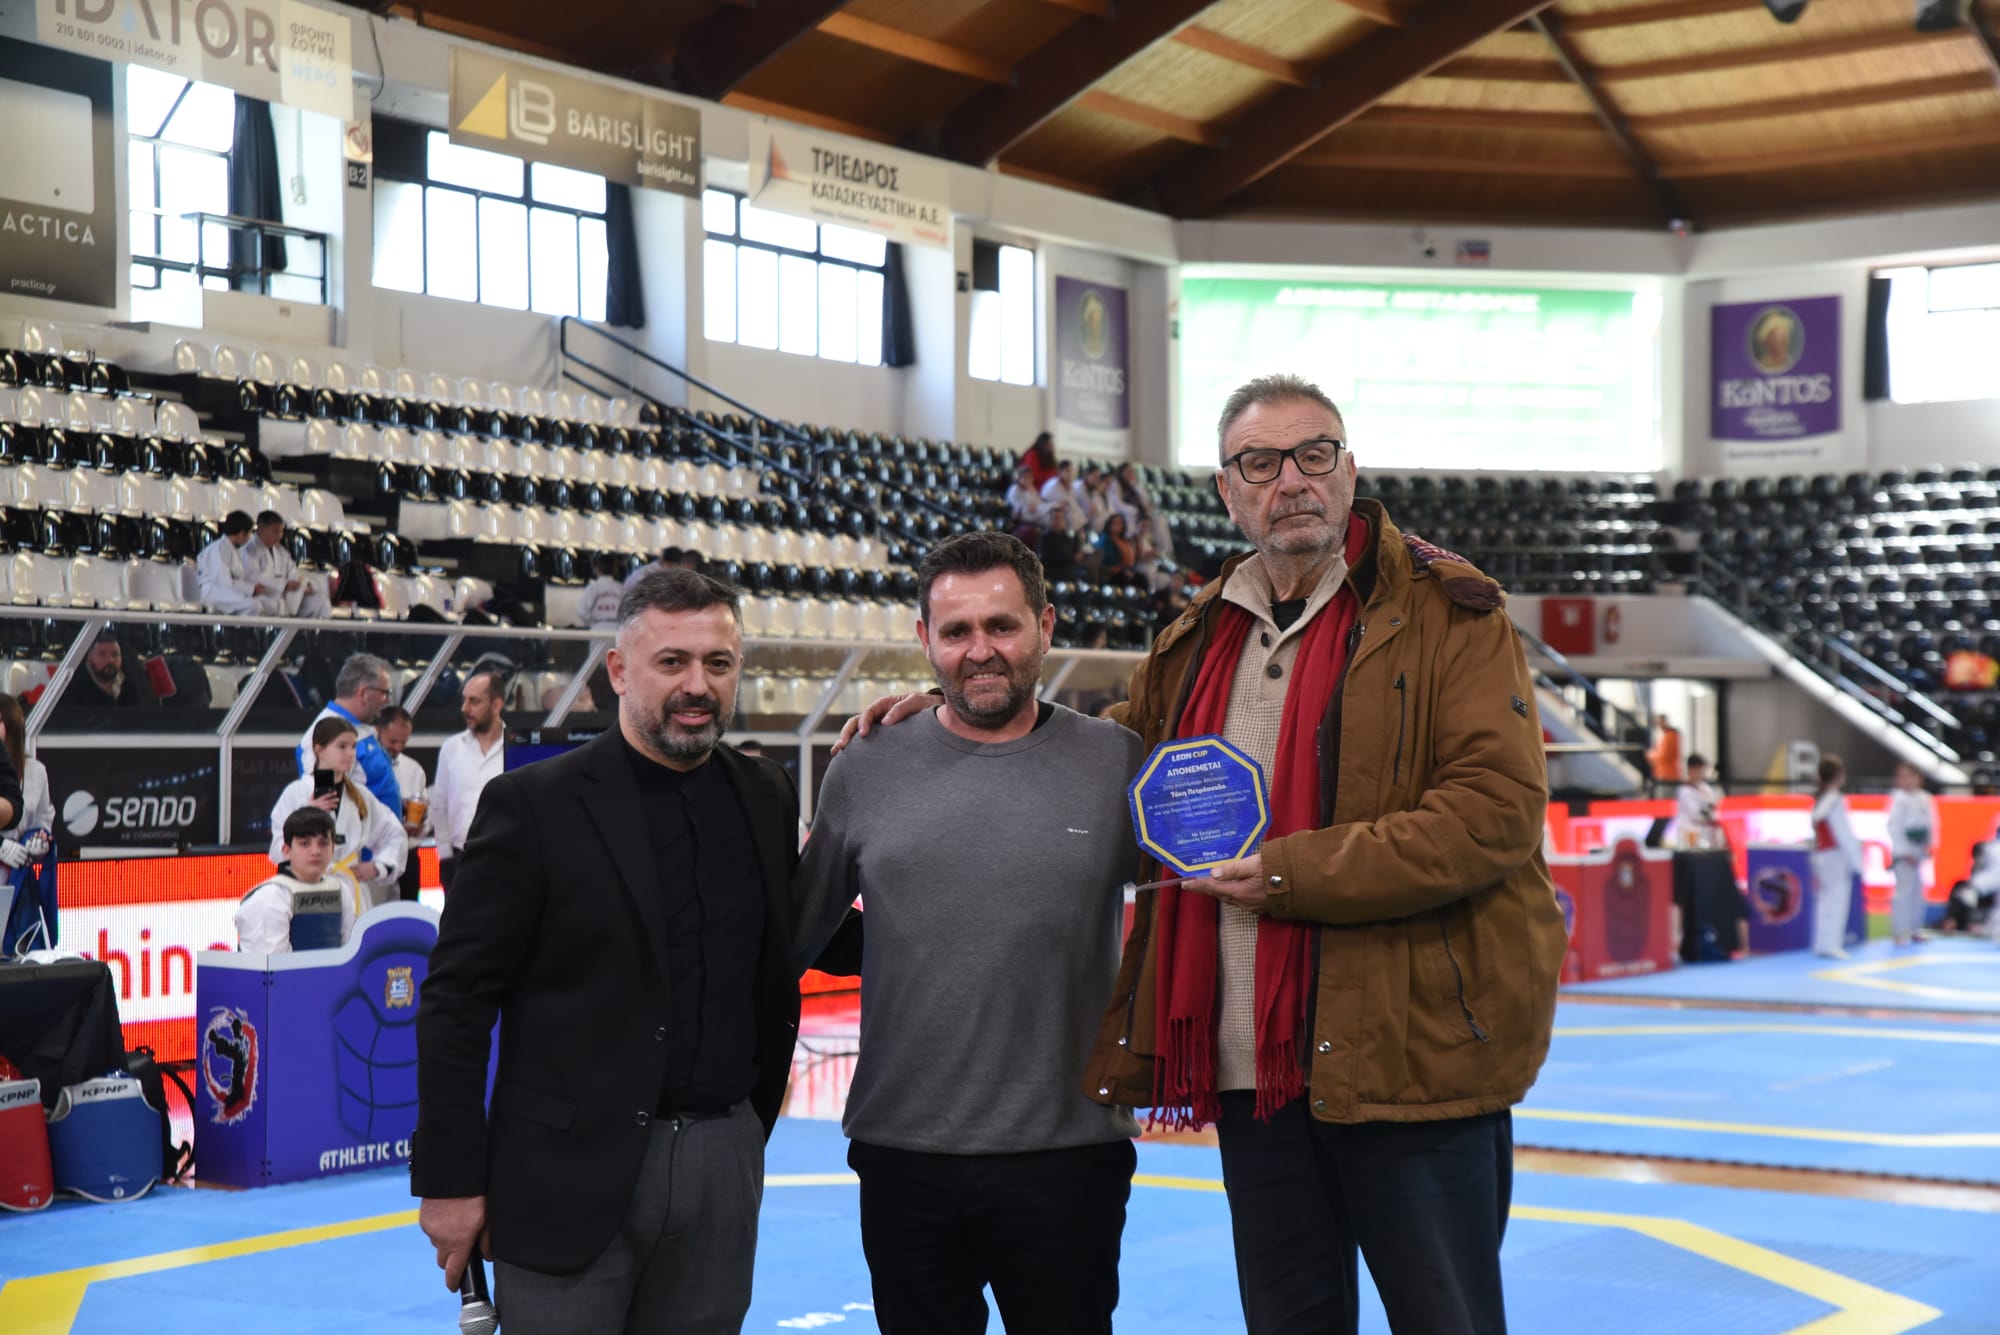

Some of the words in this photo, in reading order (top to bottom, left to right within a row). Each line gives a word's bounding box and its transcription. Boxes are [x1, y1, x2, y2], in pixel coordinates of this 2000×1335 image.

[56, 22, 74, 38] 210
[77, 27, 95, 43] 801
[134, 43, 177, 65] idator.gr
[567, 108, 696, 162] BARISLIGHT
[637, 159, 696, 186] barislight.eu
[811, 147, 899, 192] ΤΡΙΕΔΡΟΣ
[812, 181, 917, 218] ΚΑΤΑΣΚΕΥΑΣΤΙΚΗ
[1167, 761, 1221, 777] ΑΠΟΝΕΜΕΤΑΙ
[82, 1083, 129, 1098] KPNP
[319, 1141, 390, 1172] ATHLETIC
